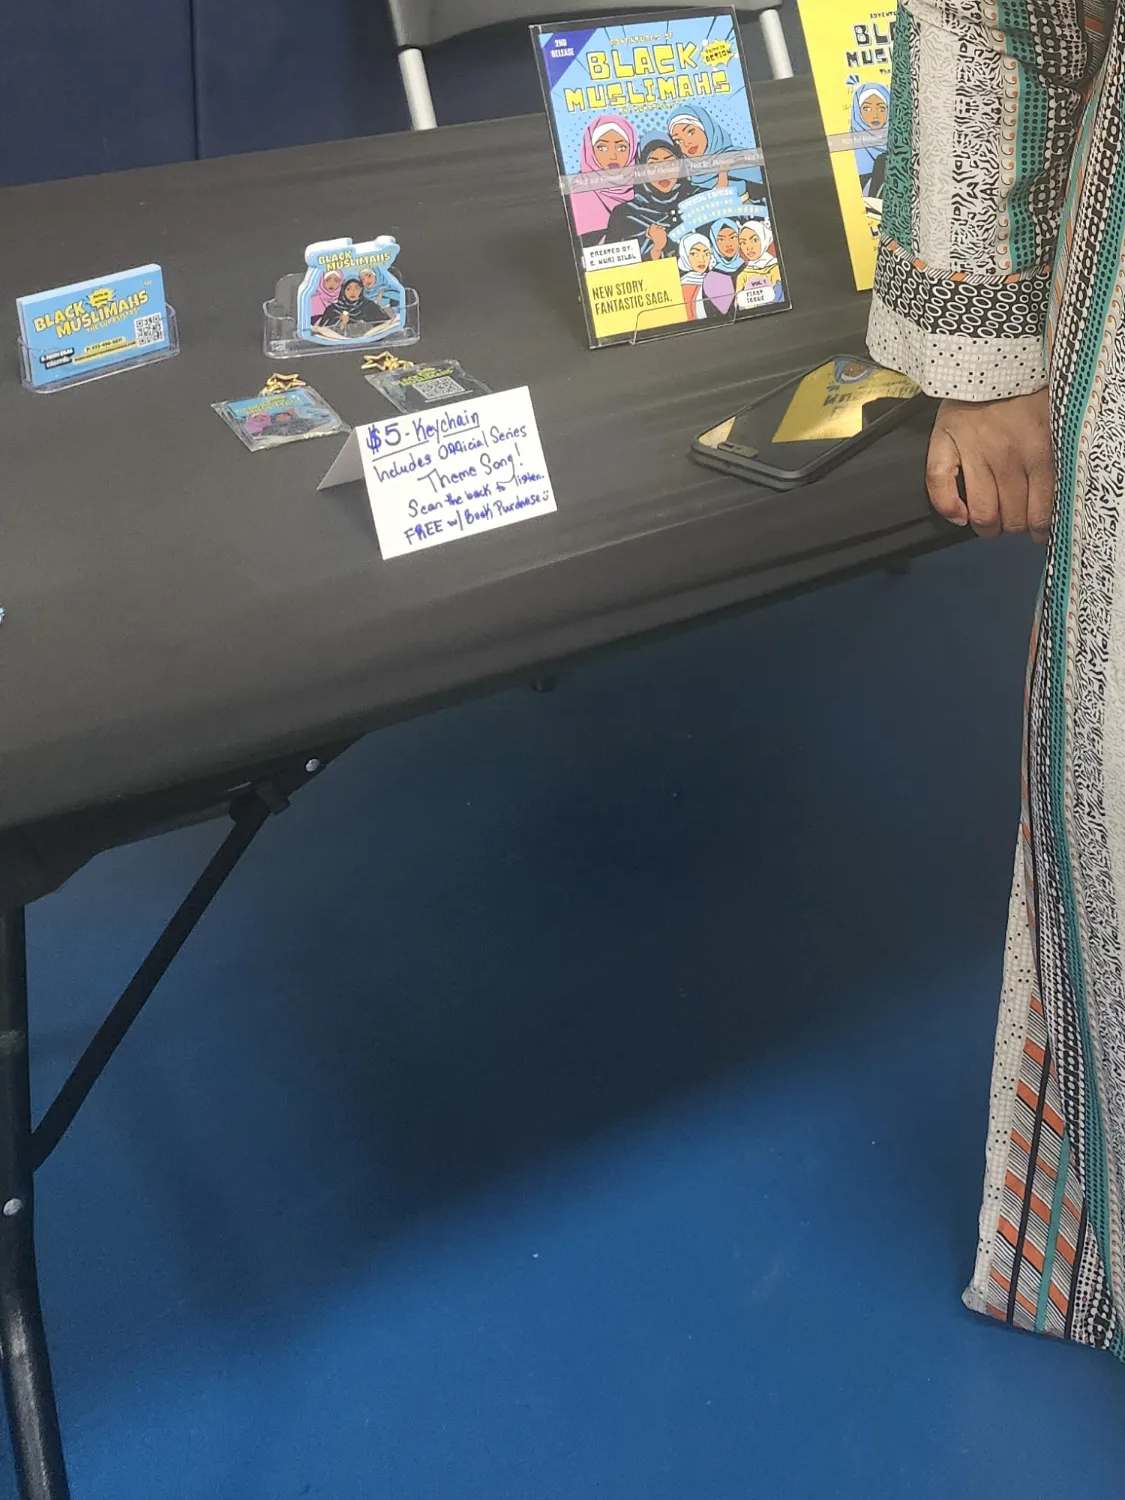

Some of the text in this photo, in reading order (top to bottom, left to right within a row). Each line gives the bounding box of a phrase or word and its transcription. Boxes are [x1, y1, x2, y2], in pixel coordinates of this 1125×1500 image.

[550, 48, 575, 59] RELEASE
[554, 38, 568, 48] 2ND
[704, 49, 732, 62] ACTION
[586, 41, 698, 81] BLACK
[563, 69, 732, 113] MUSLIMAHS
[634, 169, 647, 178] Not
[318, 250, 353, 265] BLACK
[326, 252, 392, 272] MUSLIMAHS
[592, 279, 648, 301] NEW STORY.
[594, 290, 673, 316] FANTASTIC SAGA.
[33, 299, 85, 333] BLACK
[55, 288, 149, 339] MUSLIMAHS
[366, 422, 401, 455] $5
[412, 409, 480, 445] Keychain
[373, 452, 432, 483] Includes
[490, 425, 527, 444] Series
[417, 442, 524, 493] Theme Song!
[408, 499, 443, 518] Scan
[444, 493, 464, 506] the
[464, 483, 492, 501] back
[496, 481, 506, 492] to
[403, 519, 443, 546] FREE
[447, 509, 464, 531] w/
[464, 502, 493, 525] Book
